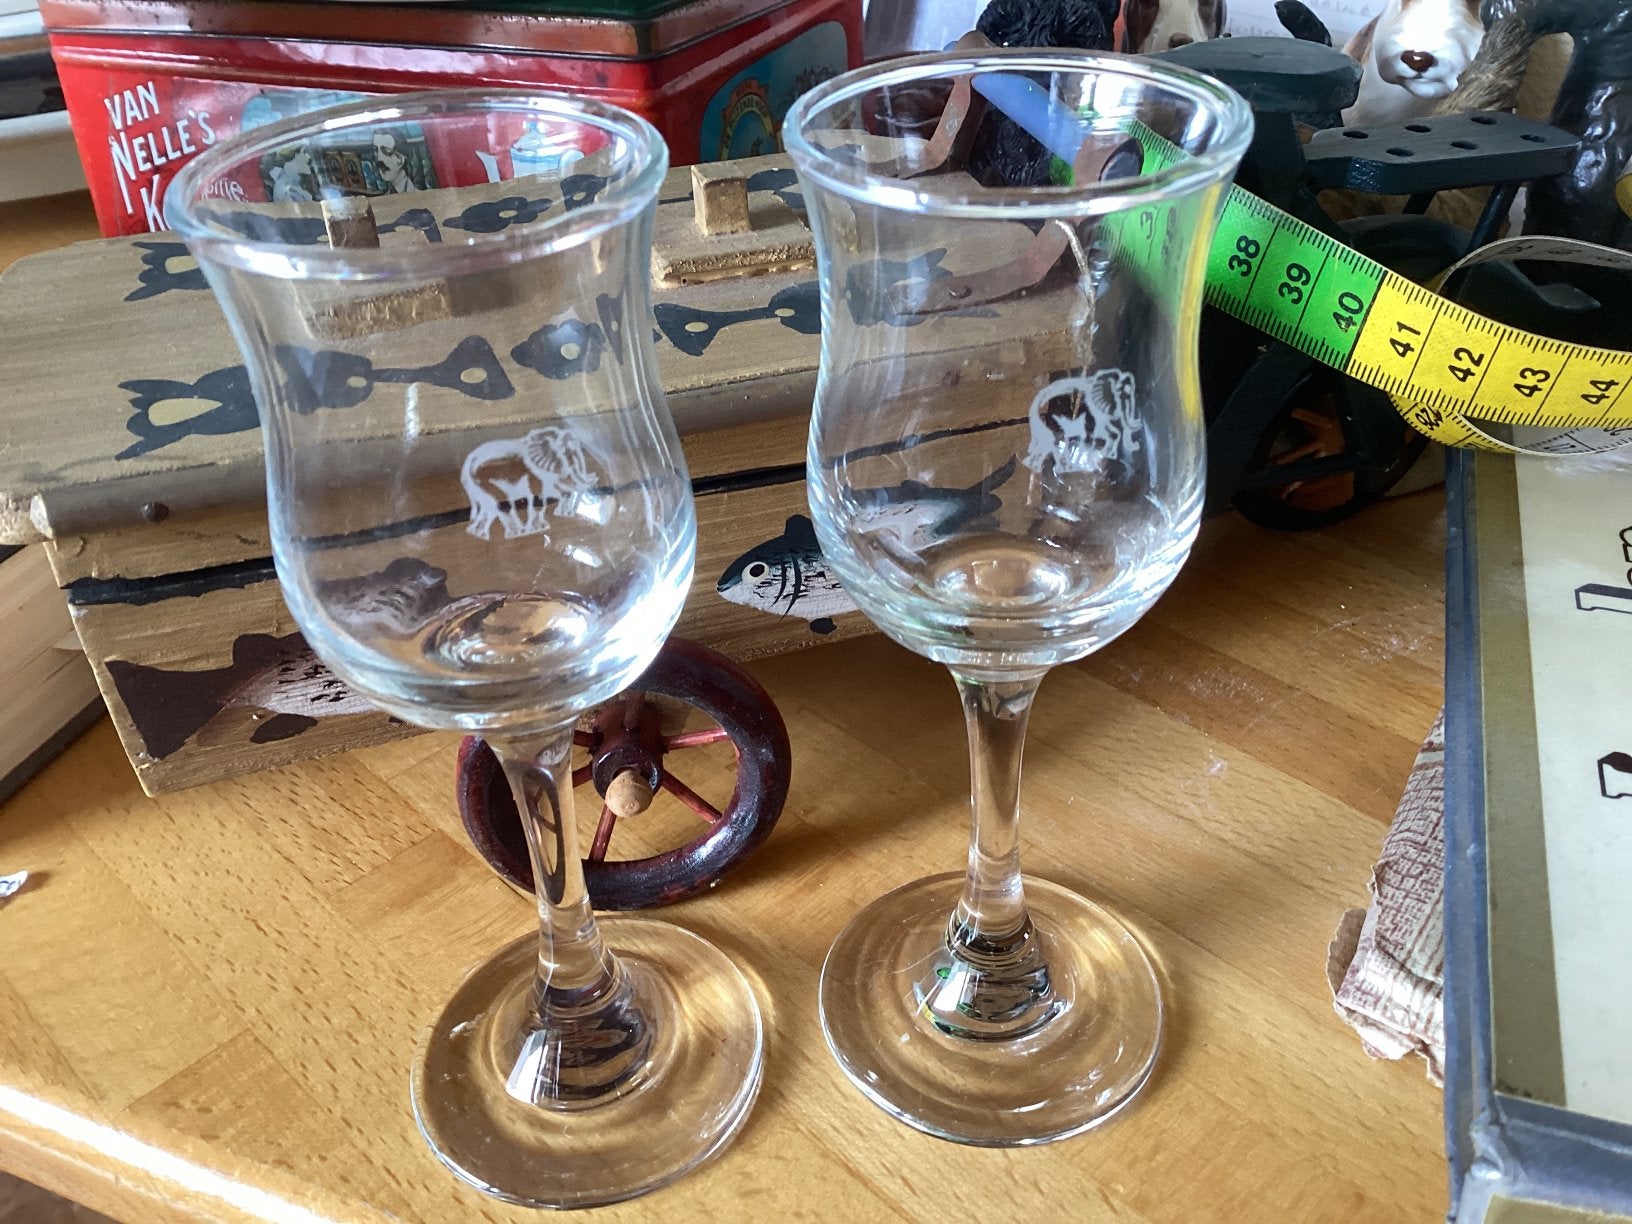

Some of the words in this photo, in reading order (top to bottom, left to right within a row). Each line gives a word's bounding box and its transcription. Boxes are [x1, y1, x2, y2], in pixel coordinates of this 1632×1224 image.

[104, 81, 160, 130] VAN
[108, 110, 216, 214] NELLE'S
[1228, 235, 1261, 277] 38
[1278, 263, 1311, 305] 39
[1333, 292, 1364, 332] 40
[1389, 321, 1421, 358] 41
[1448, 347, 1485, 383] 42
[1513, 367, 1551, 398] 43
[1580, 379, 1619, 405] 44
